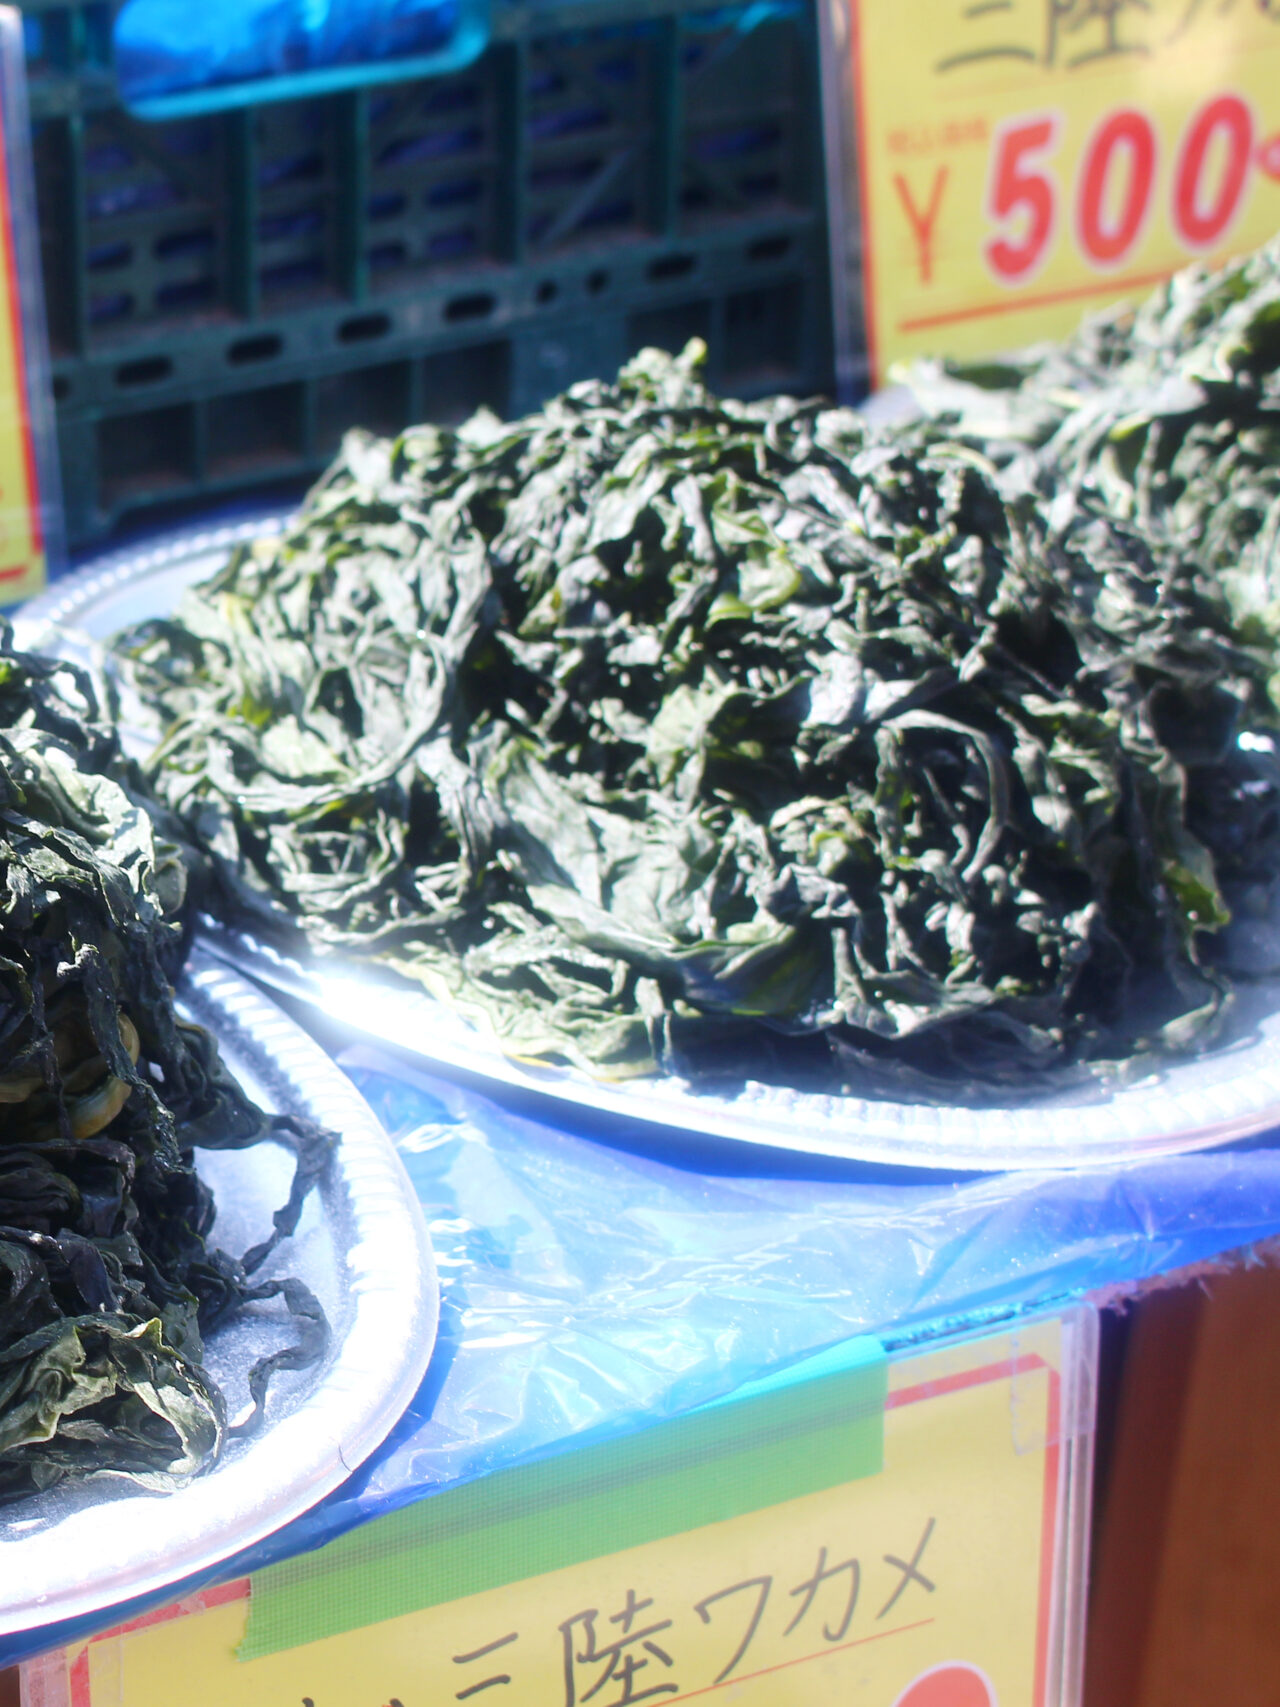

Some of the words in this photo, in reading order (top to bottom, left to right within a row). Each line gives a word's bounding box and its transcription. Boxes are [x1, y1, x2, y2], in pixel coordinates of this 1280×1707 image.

[301, 1516, 936, 1707] 三陸ワカメ
